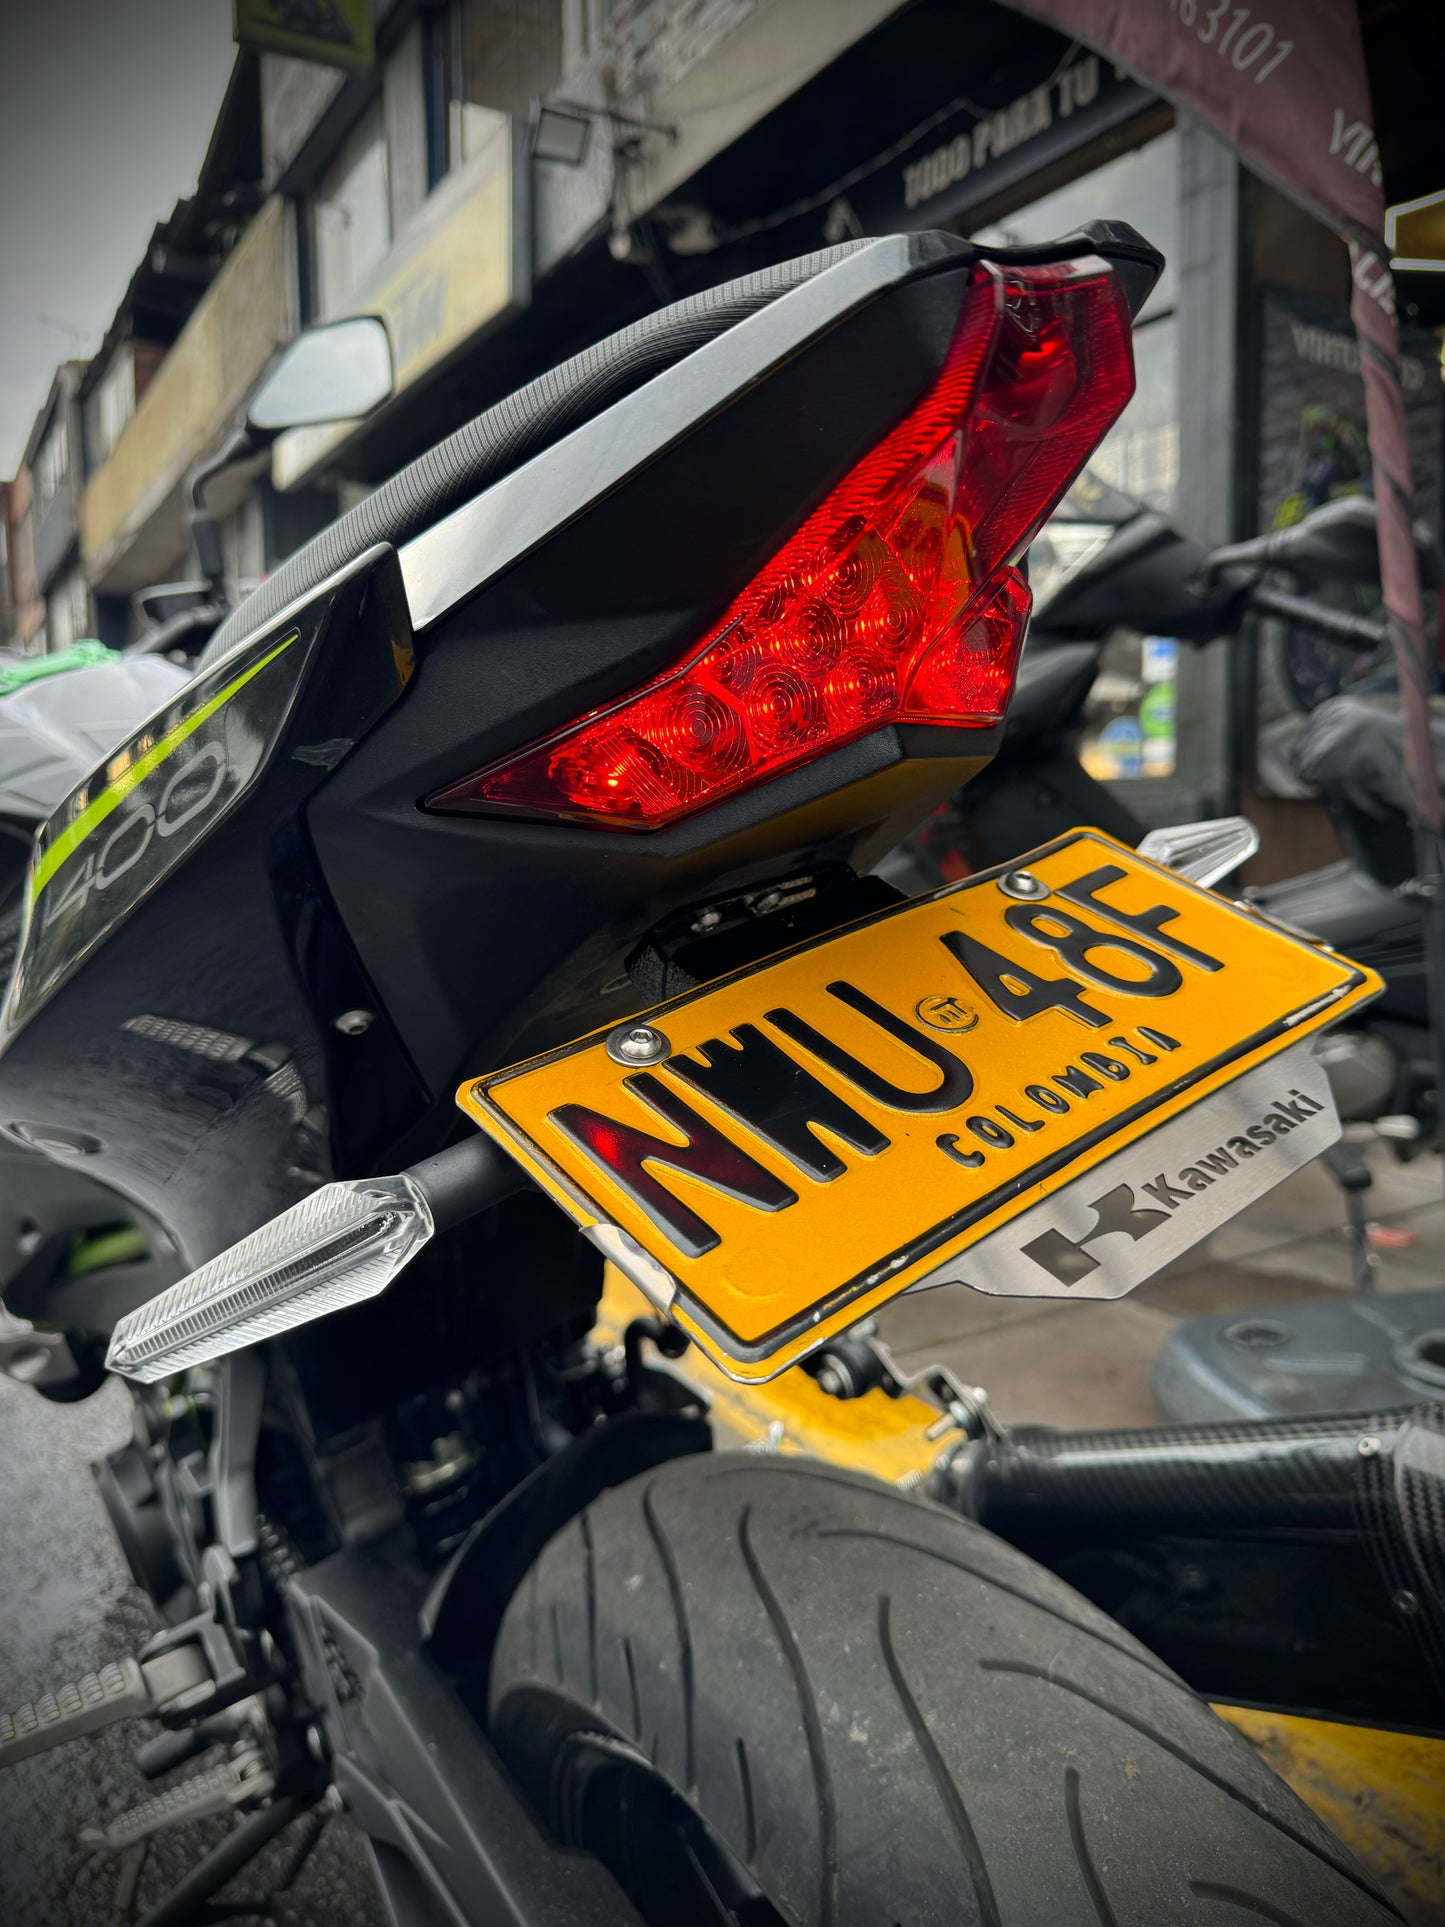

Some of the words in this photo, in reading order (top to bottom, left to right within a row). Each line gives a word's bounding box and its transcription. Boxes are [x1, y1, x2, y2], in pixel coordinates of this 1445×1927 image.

[1055, 55, 1100, 118] TU
[1171, 0, 1295, 84] 3101
[46, 740, 227, 928] 400
[547, 979, 975, 1257] NWU
[939, 864, 1225, 1030] 48F
[935, 1026, 1182, 1169] COLOMBIA
[1140, 1088, 1325, 1210] Kawasaki
